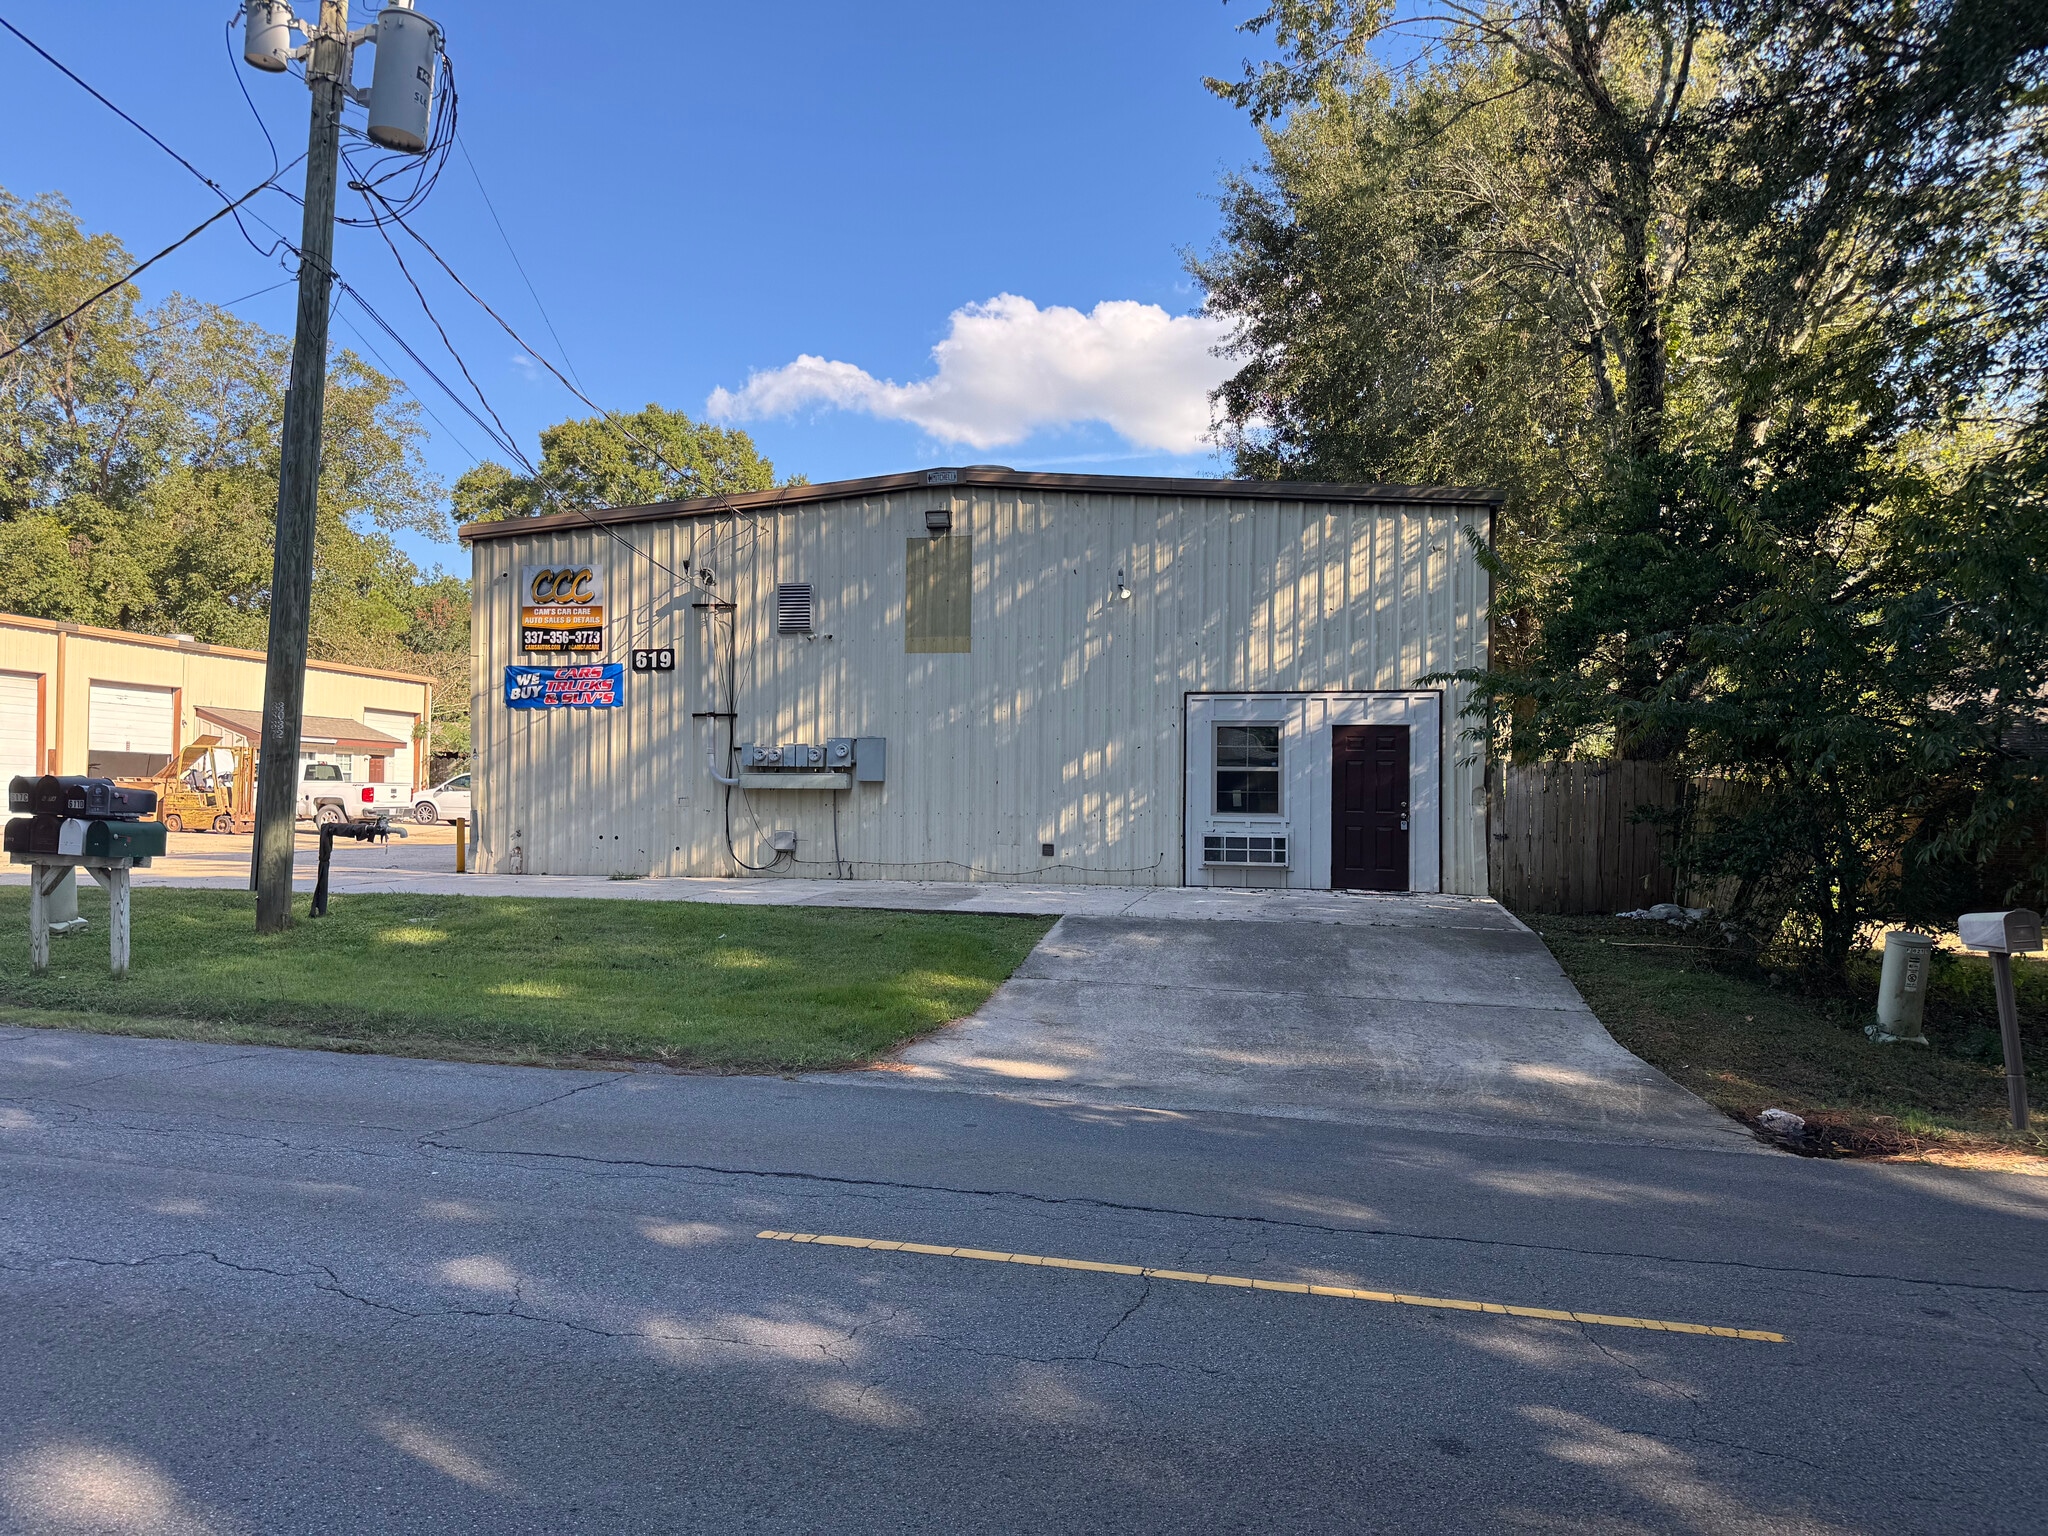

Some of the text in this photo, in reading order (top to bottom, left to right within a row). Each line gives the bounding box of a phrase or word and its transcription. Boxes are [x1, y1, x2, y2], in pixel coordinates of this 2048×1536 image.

[531, 567, 595, 605] CCC
[534, 608, 591, 616] CAM'S CAR CARE
[524, 616, 543, 624] AUTO
[544, 616, 565, 624] SALES
[573, 616, 600, 624] DETAILS
[524, 630, 600, 644] 337-356-3773
[635, 651, 672, 669] 619
[516, 673, 541, 686] WE
[553, 667, 604, 680] CARS
[510, 684, 543, 700] BUY
[545, 679, 614, 692] TRUCKS
[543, 692, 615, 704] & SUV'S
